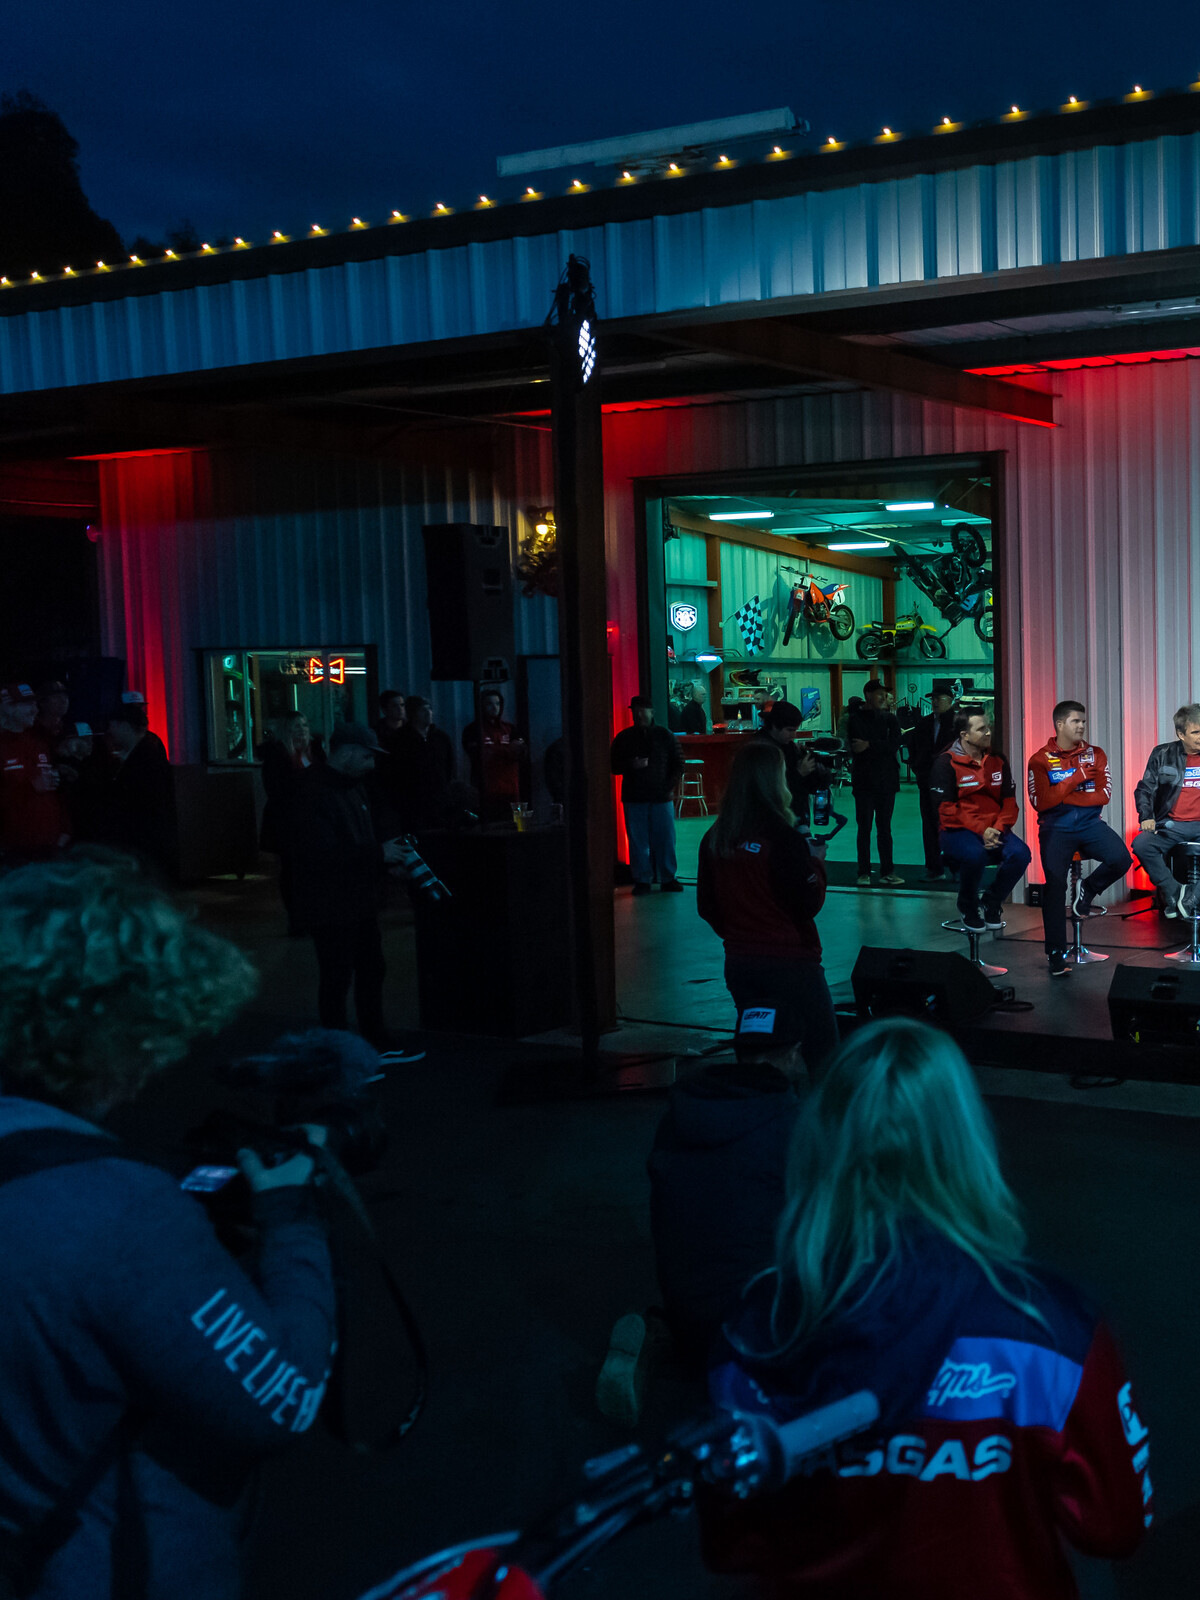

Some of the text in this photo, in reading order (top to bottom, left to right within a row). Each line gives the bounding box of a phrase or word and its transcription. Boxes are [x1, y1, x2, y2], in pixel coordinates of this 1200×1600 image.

[190, 1287, 308, 1425] LIVE LIFE
[838, 1433, 1013, 1482] SGAS
